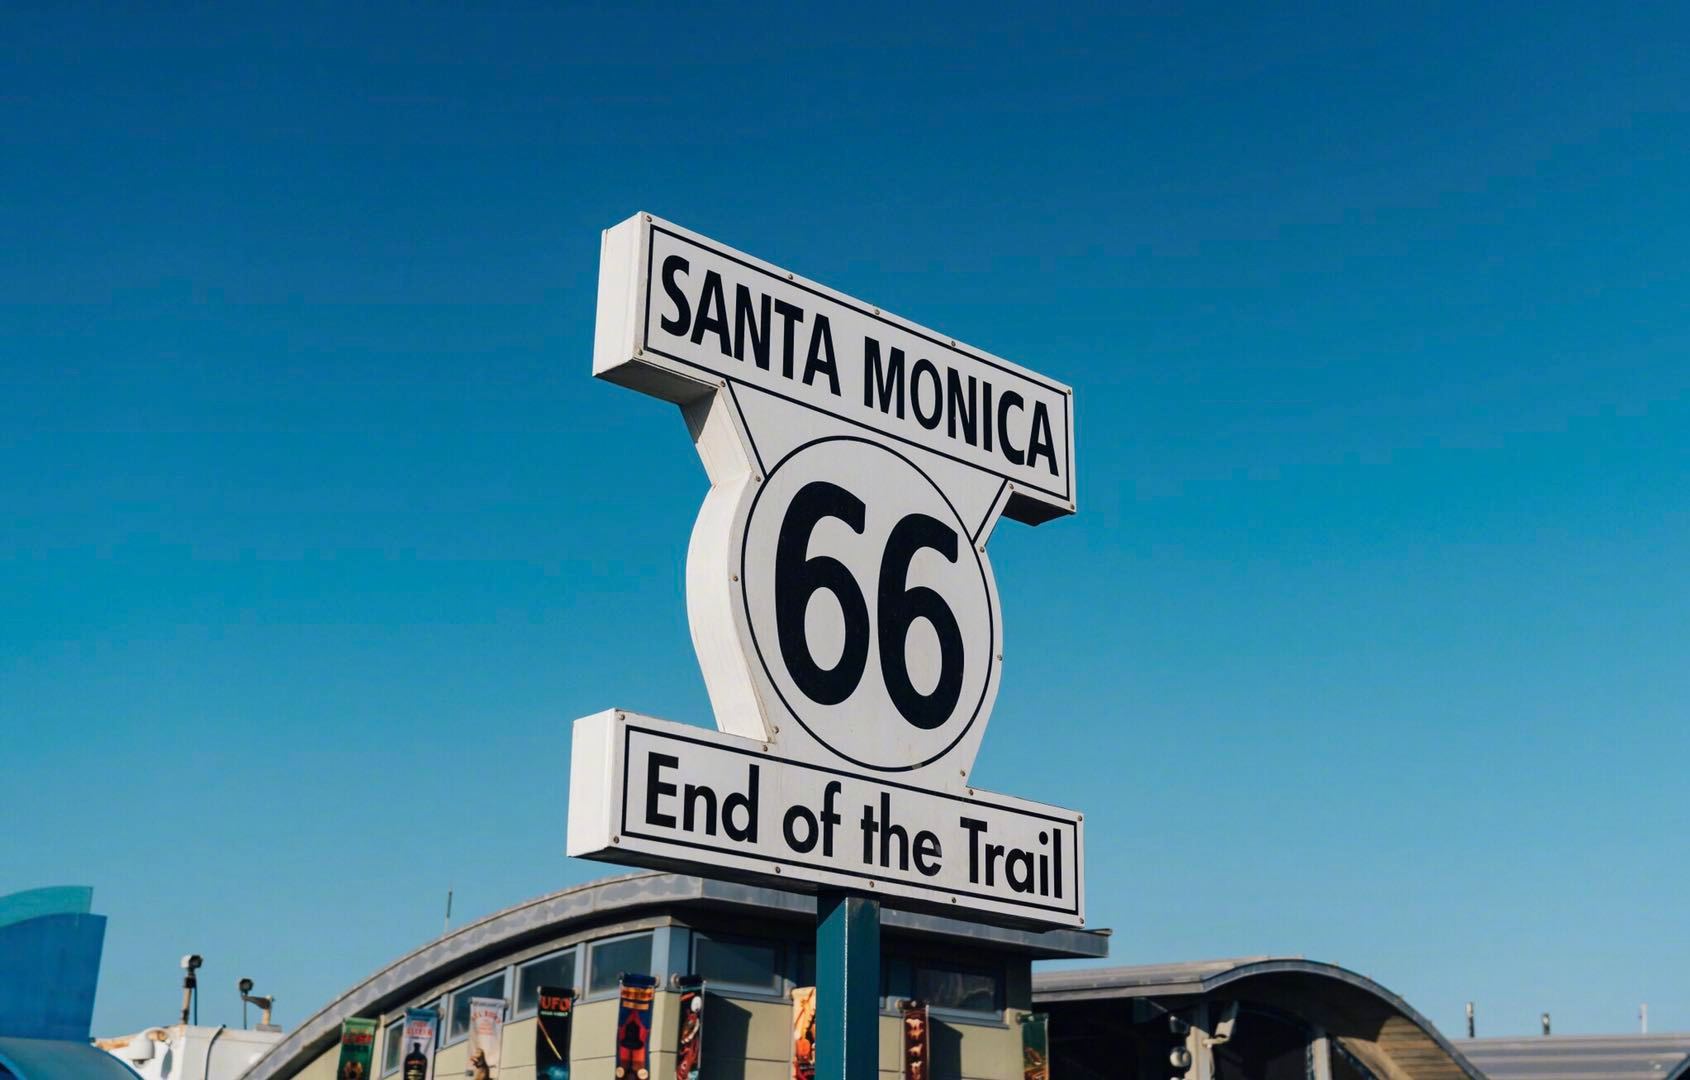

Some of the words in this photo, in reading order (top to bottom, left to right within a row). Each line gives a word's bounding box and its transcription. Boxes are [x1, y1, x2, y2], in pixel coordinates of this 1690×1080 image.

[661, 255, 842, 397] SANTA
[864, 336, 1060, 477] MONICA
[775, 481, 965, 731] 66
[646, 752, 760, 844] End
[783, 781, 842, 858] of
[861, 792, 943, 877] the
[960, 817, 1063, 900] Trail
[540, 996, 571, 1011] UFO
